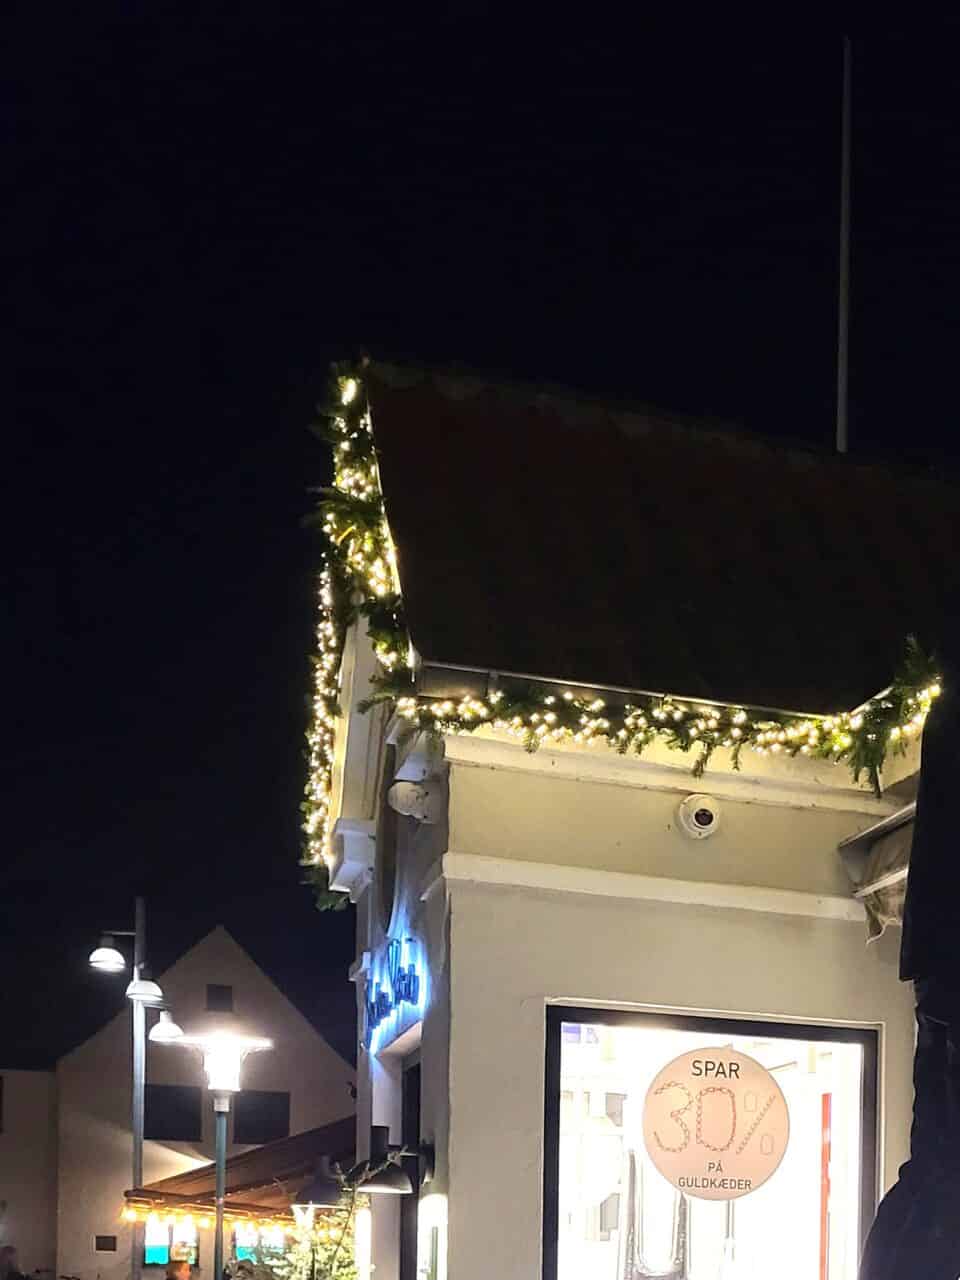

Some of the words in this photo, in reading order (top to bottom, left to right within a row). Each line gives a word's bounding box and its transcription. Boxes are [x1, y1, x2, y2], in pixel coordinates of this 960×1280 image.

[691, 1059, 741, 1080] SPAR
[652, 1080, 778, 1156] 30%
[707, 1160, 724, 1174] PÅ
[678, 1176, 753, 1190] GULDKÆDER
